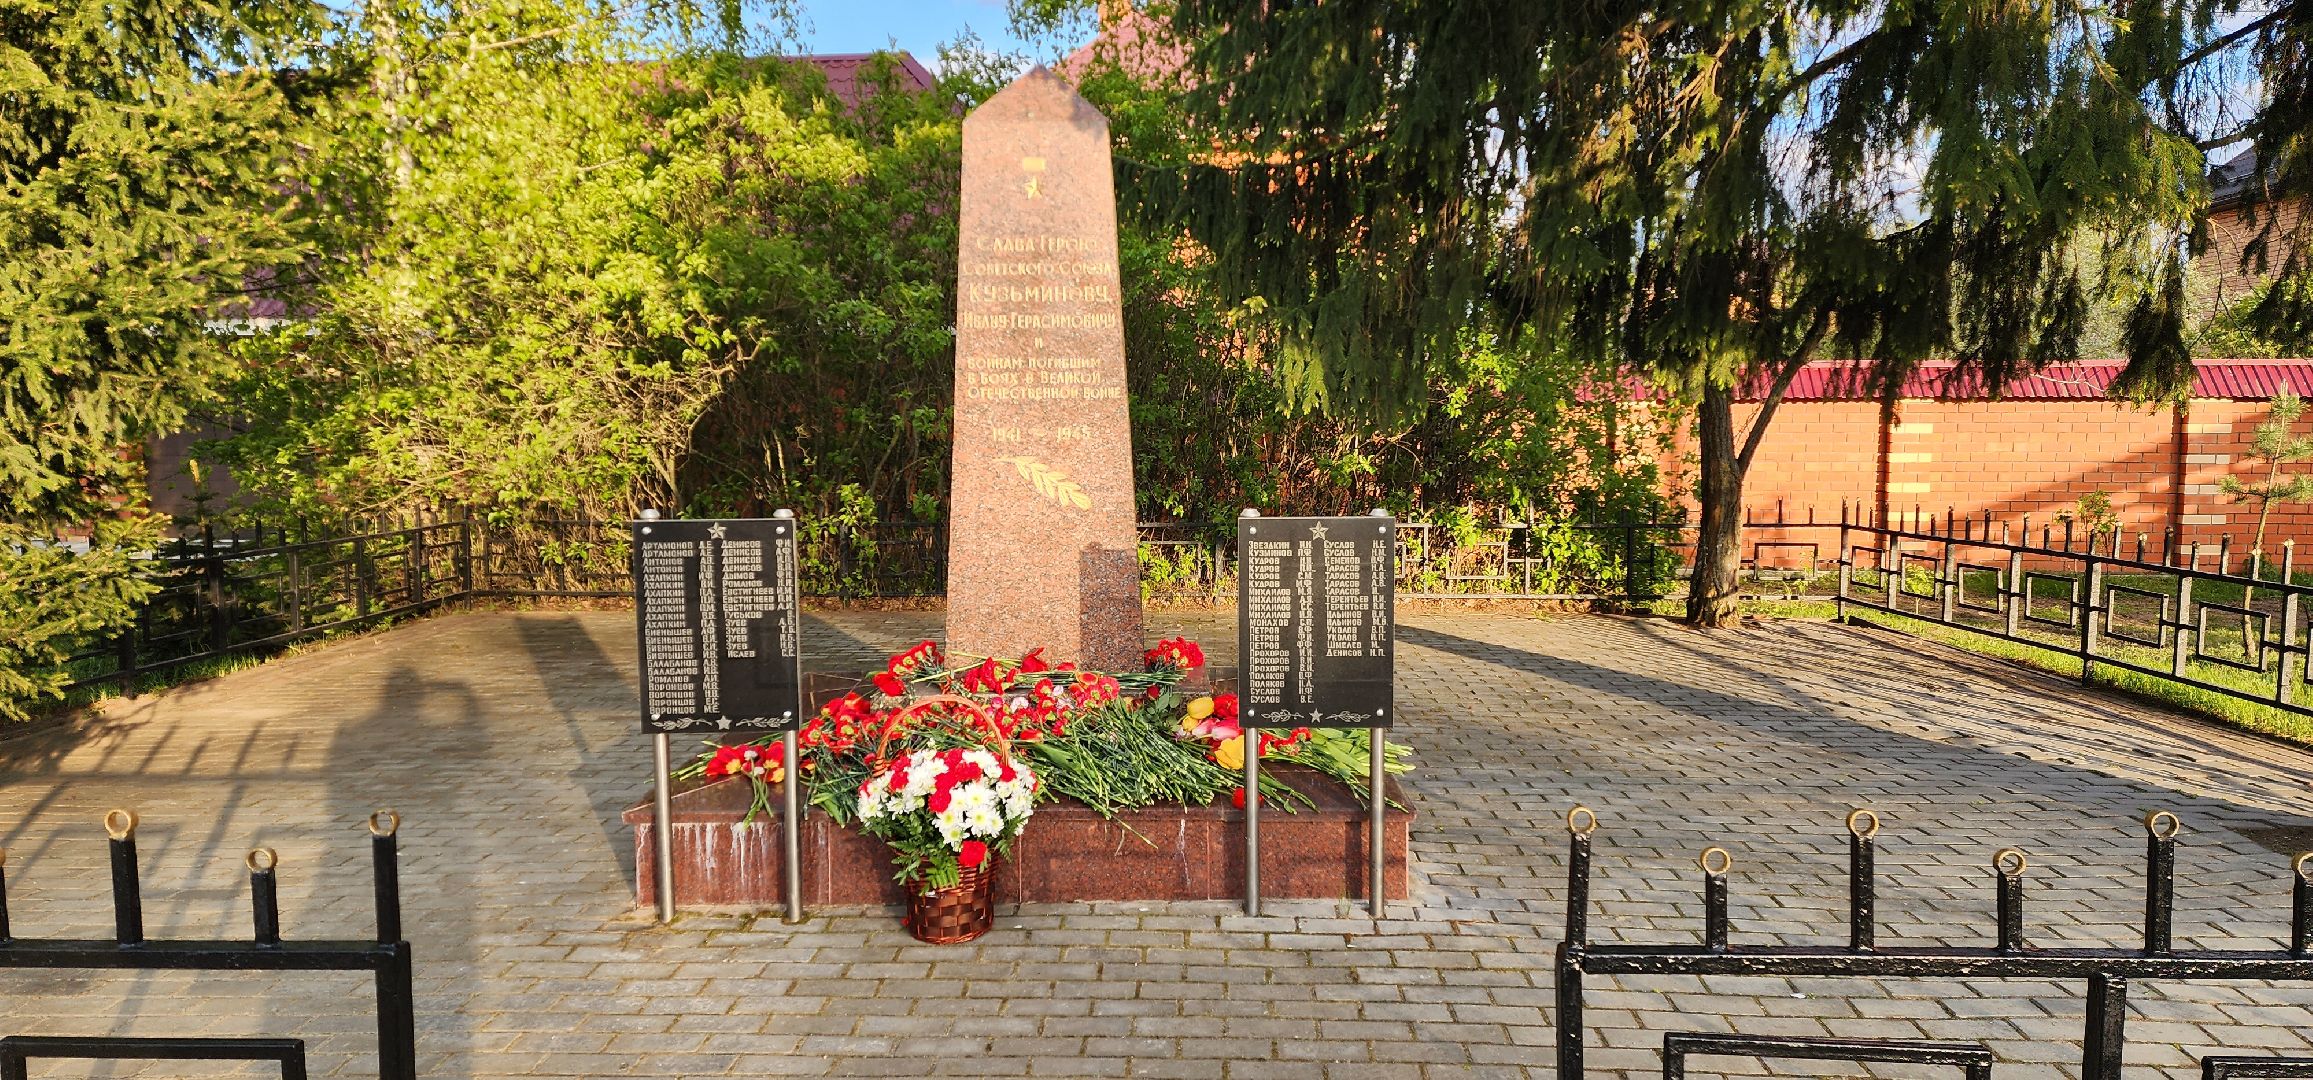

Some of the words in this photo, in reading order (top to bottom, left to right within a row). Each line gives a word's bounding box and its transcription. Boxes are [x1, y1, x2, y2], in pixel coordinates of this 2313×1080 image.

[642, 542, 693, 550] АРТАМОНОВ
[721, 540, 761, 548] ДЕНИСОВ
[1248, 541, 1290, 549] ЗВЕЗДКИН
[1324, 540, 1355, 548] СУСЛОВ
[721, 548, 761, 556] ДЕНИСОВ
[643, 558, 683, 566] АНТОНОВ
[722, 556, 761, 564] ДЕНИСОВ
[722, 564, 762, 572] ДЕНИСОВ
[1325, 564, 1360, 572] ТАРАСОВ
[1249, 572, 1280, 580] КУДРОВ
[1325, 572, 1360, 580] ТАРАСОВ
[1325, 587, 1360, 595] ТАРАСОВ
[723, 595, 774, 603] ЕВСТИГНЕЕВ
[1325, 595, 1369, 603] ТЕРЕНТЬЕВ
[1325, 603, 1369, 611] ТЕРЕНТЬЕВ
[725, 619, 747, 627] ЗУЕВ
[1250, 626, 1279, 634] ПЕТРОВ
[1327, 626, 1357, 634] УКОЛОВ
[646, 644, 693, 652] БИЕНЫШЕВ
[1327, 641, 1361, 649] ШМЕЛЕВ
[647, 652, 693, 660] БИЕНЫШЕВ
[728, 650, 755, 658] ИСАЕВ
[1250, 672, 1285, 680] ПОЛЯКОВ
[648, 683, 694, 691] ВОРОНЦОВ
[1250, 680, 1285, 688] ПОЛЯКОВ
[1250, 695, 1280, 703] СУСЛОВ
